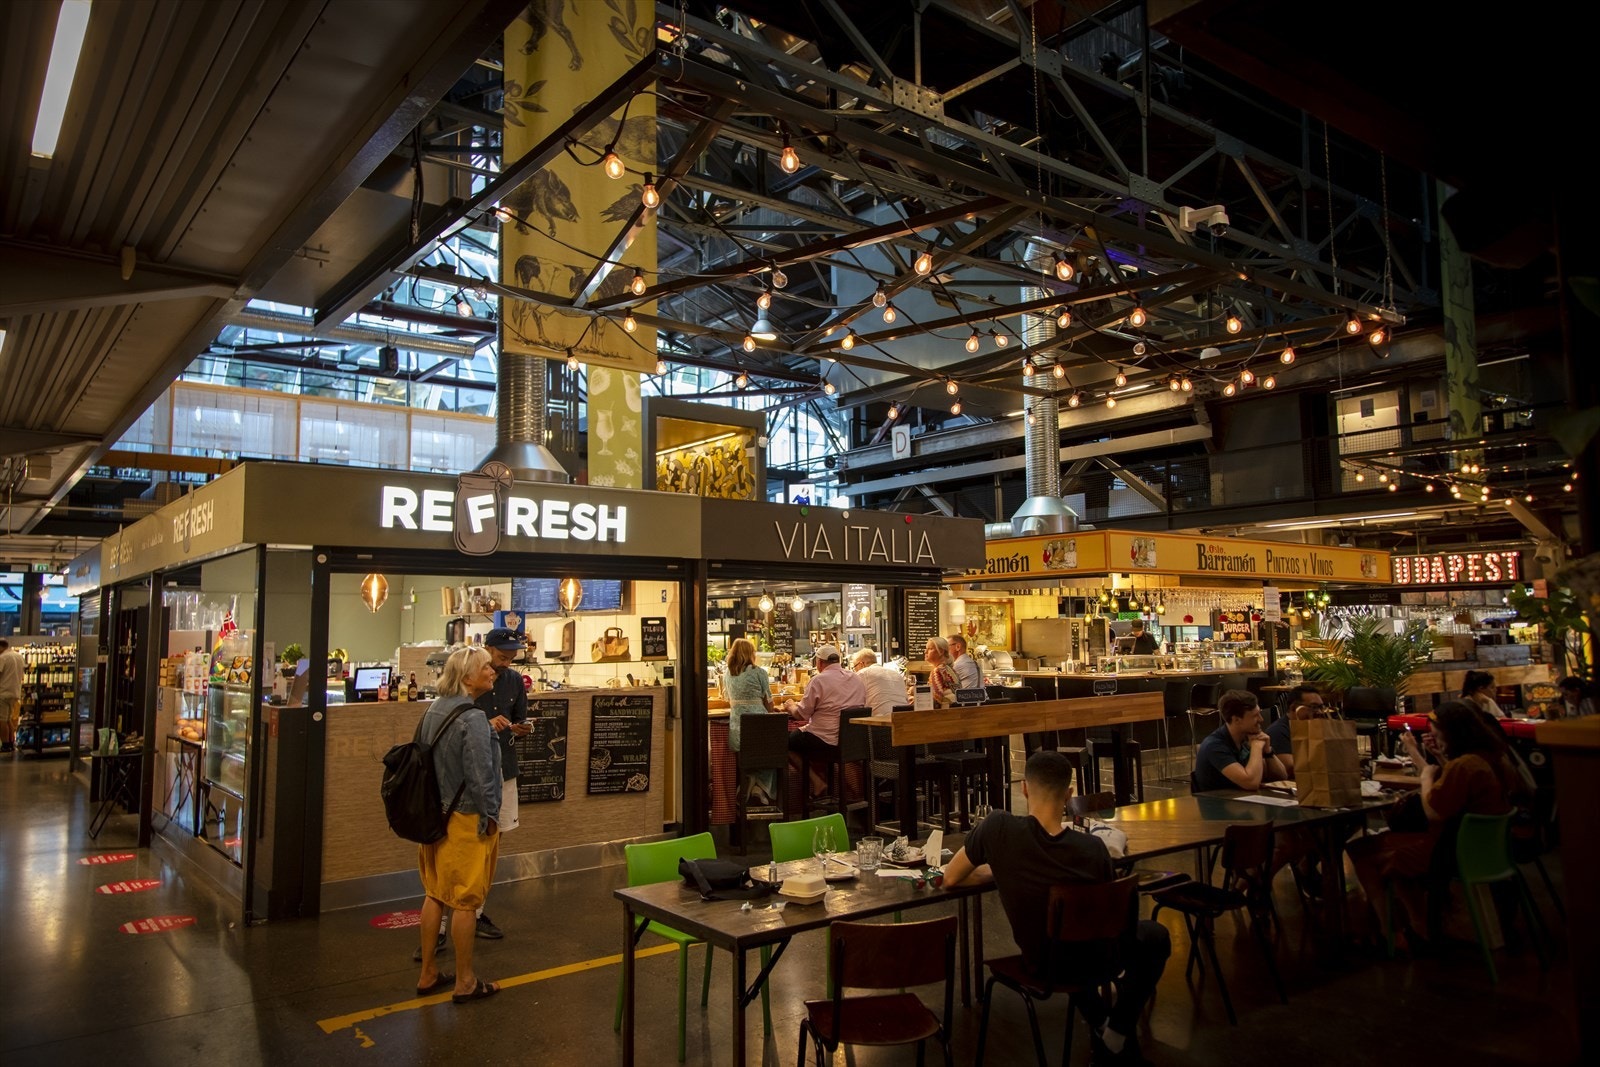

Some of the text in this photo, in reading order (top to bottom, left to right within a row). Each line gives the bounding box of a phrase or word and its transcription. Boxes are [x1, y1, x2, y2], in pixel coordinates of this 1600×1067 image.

[895, 431, 907, 454] D
[173, 499, 214, 544] REFRESH
[380, 486, 627, 543] REFRESH
[774, 521, 936, 565] VIA ITALIA
[966, 552, 1030, 574] amón
[1196, 543, 1256, 573] Barramón
[1395, 550, 1521, 585] UDAPEST
[1223, 622, 1251, 634] BURGER
[541, 709, 566, 717] COFFEE
[609, 708, 651, 716] SANDWICHES
[622, 754, 648, 762] WRAPS
[540, 775, 564, 783] MOCCA
